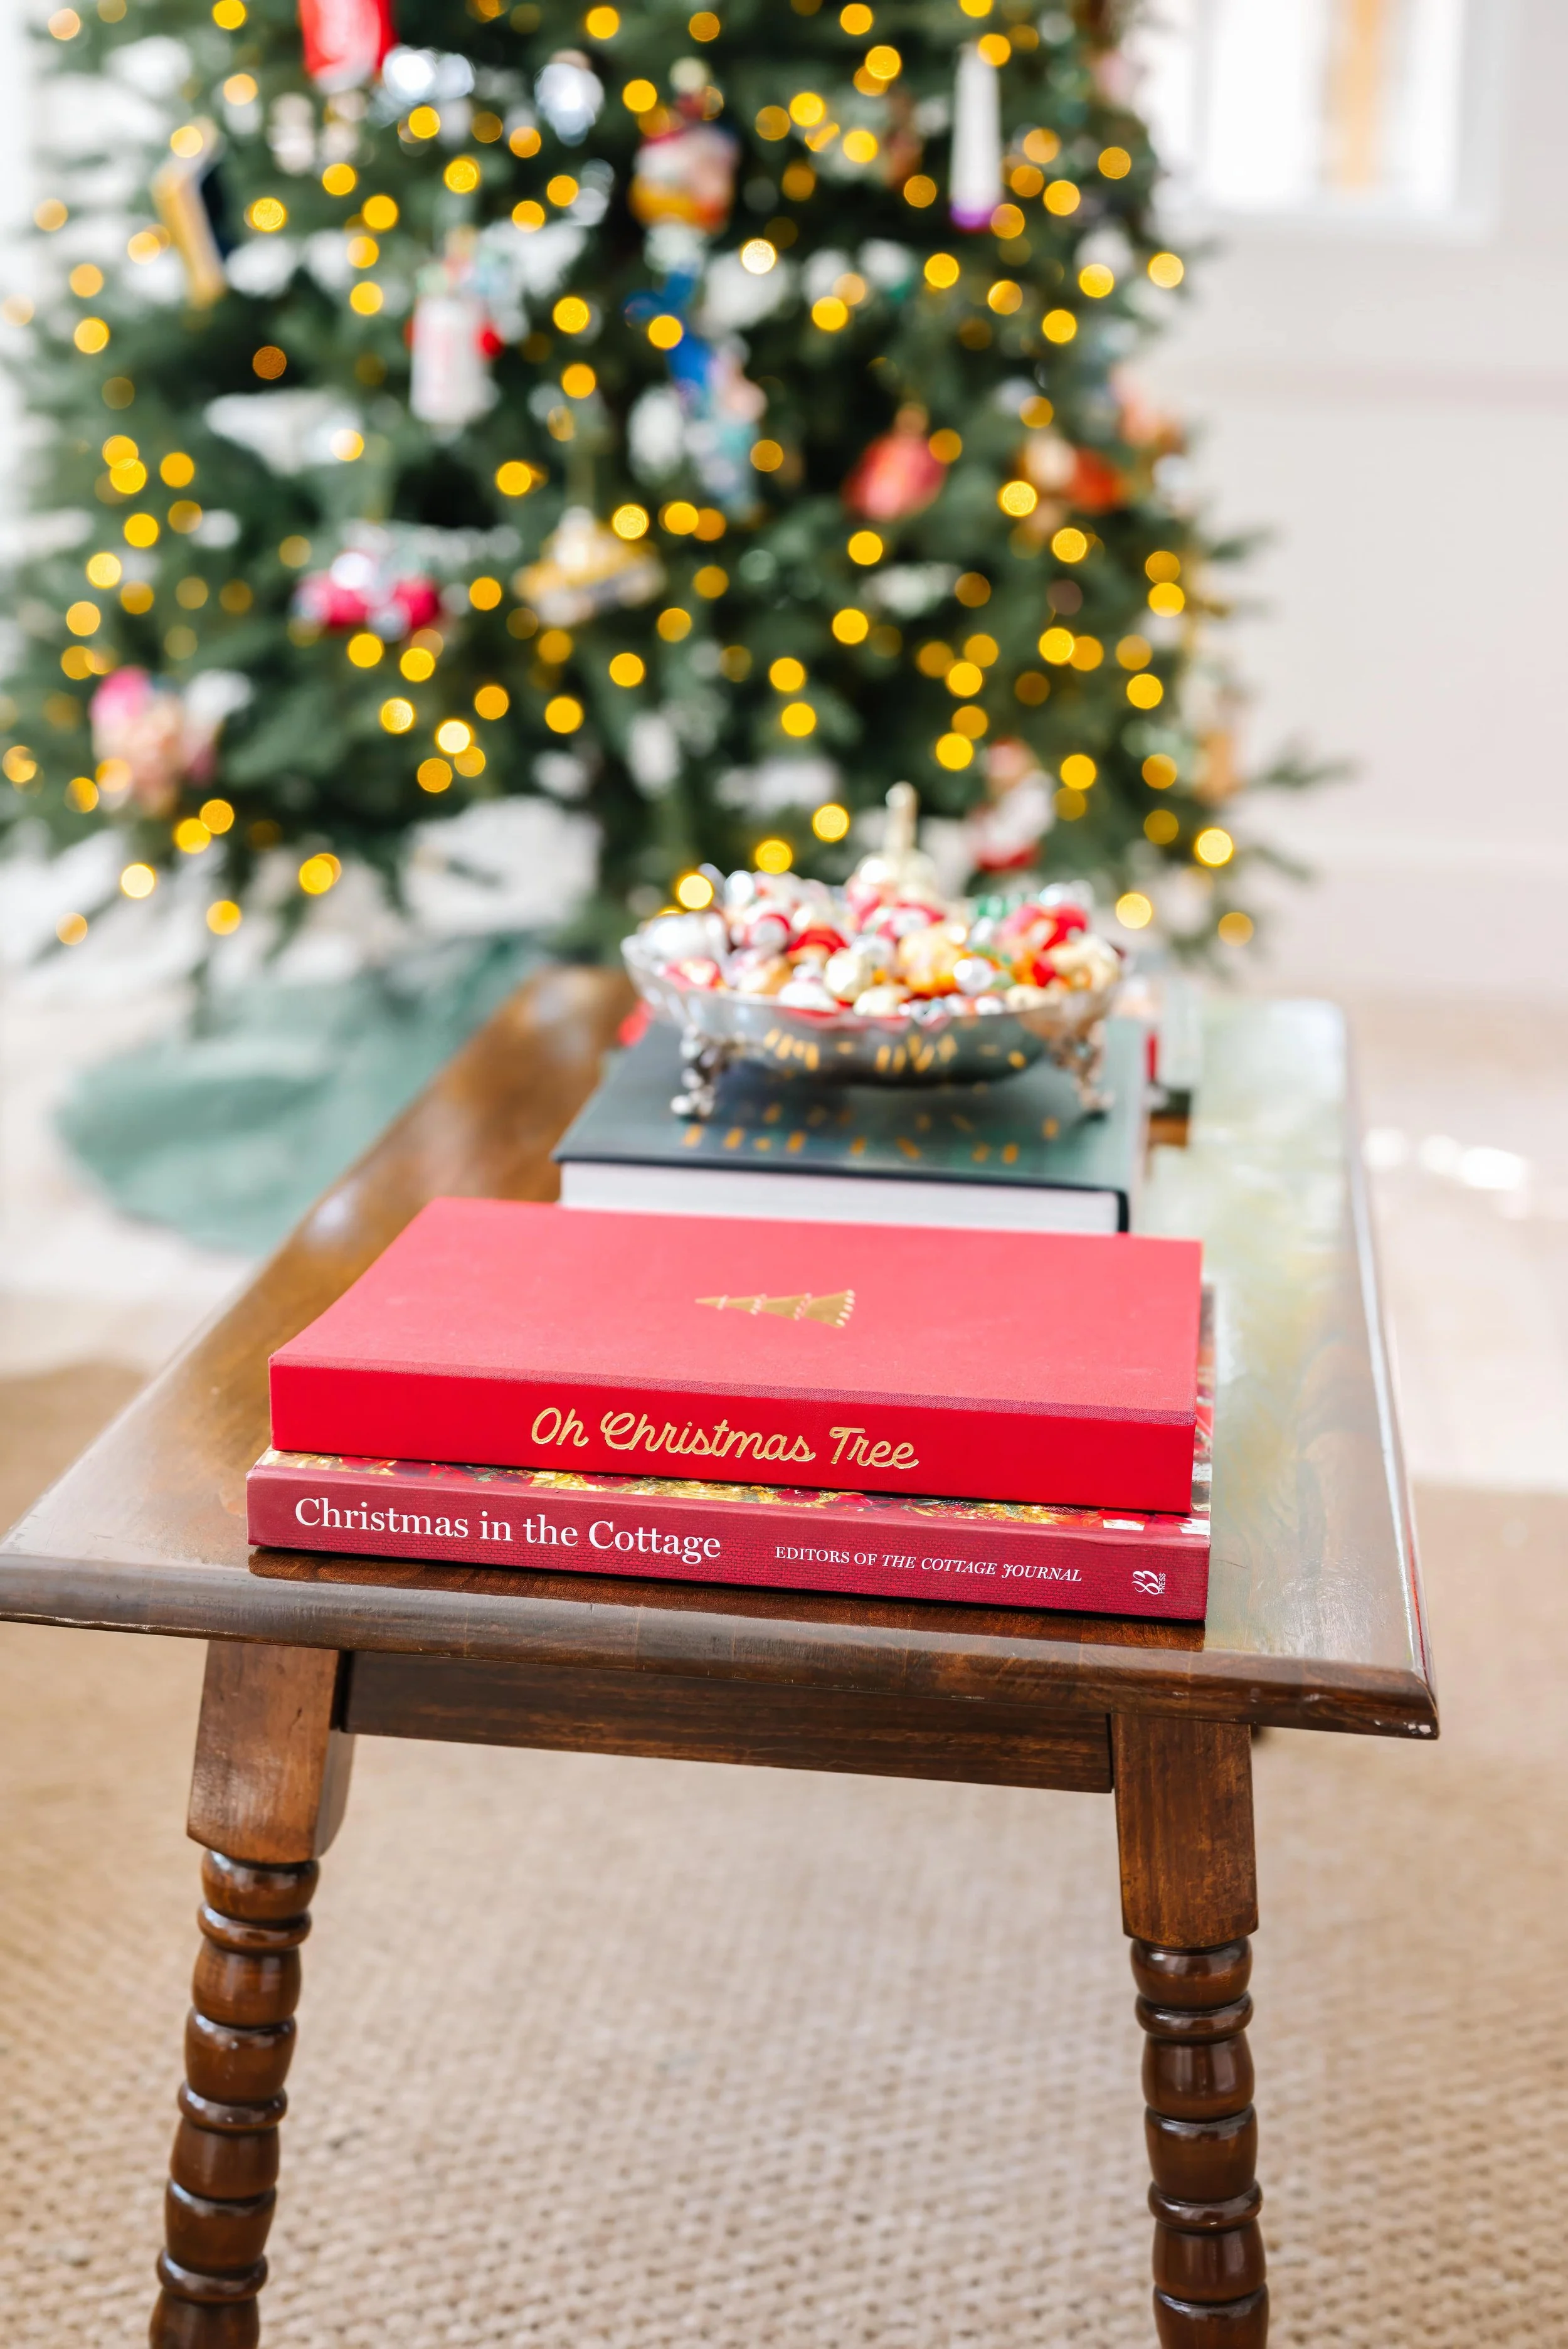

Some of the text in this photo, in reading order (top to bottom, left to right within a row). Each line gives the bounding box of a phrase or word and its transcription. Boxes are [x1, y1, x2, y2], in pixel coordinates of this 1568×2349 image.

[531, 1407, 919, 1470] Oh Christmas Tree
[295, 1497, 721, 1564] Christmas in the Cottage
[775, 1546, 1083, 1583] EDITORS OF THE COTTAGE JOURNAL
